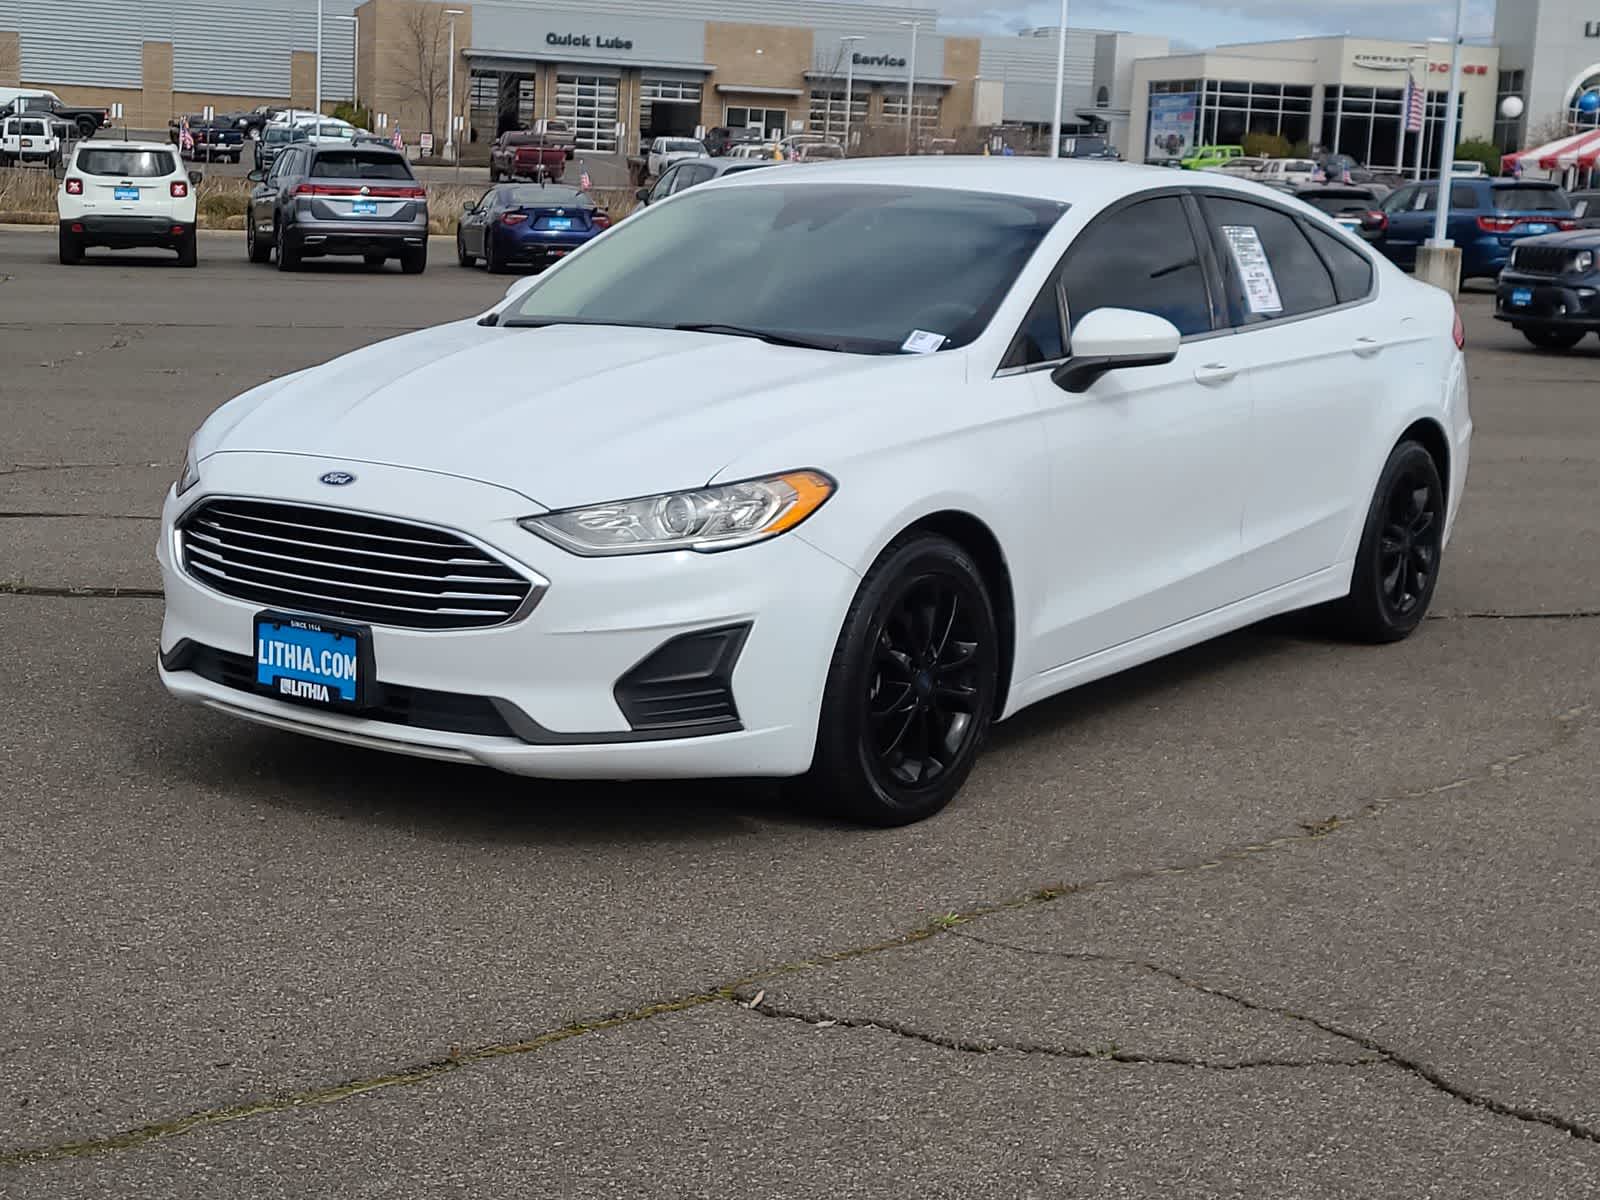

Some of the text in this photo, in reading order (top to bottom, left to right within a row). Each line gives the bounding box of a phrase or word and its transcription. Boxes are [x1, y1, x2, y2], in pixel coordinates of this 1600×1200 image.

[546, 32, 633, 50] Quick Lube
[852, 53, 906, 67] Service
[1428, 63, 1488, 76] DOGE
[290, 619, 307, 630] SINCE
[258, 638, 357, 682] LITHIA.COM
[291, 679, 330, 703] LITHIA
